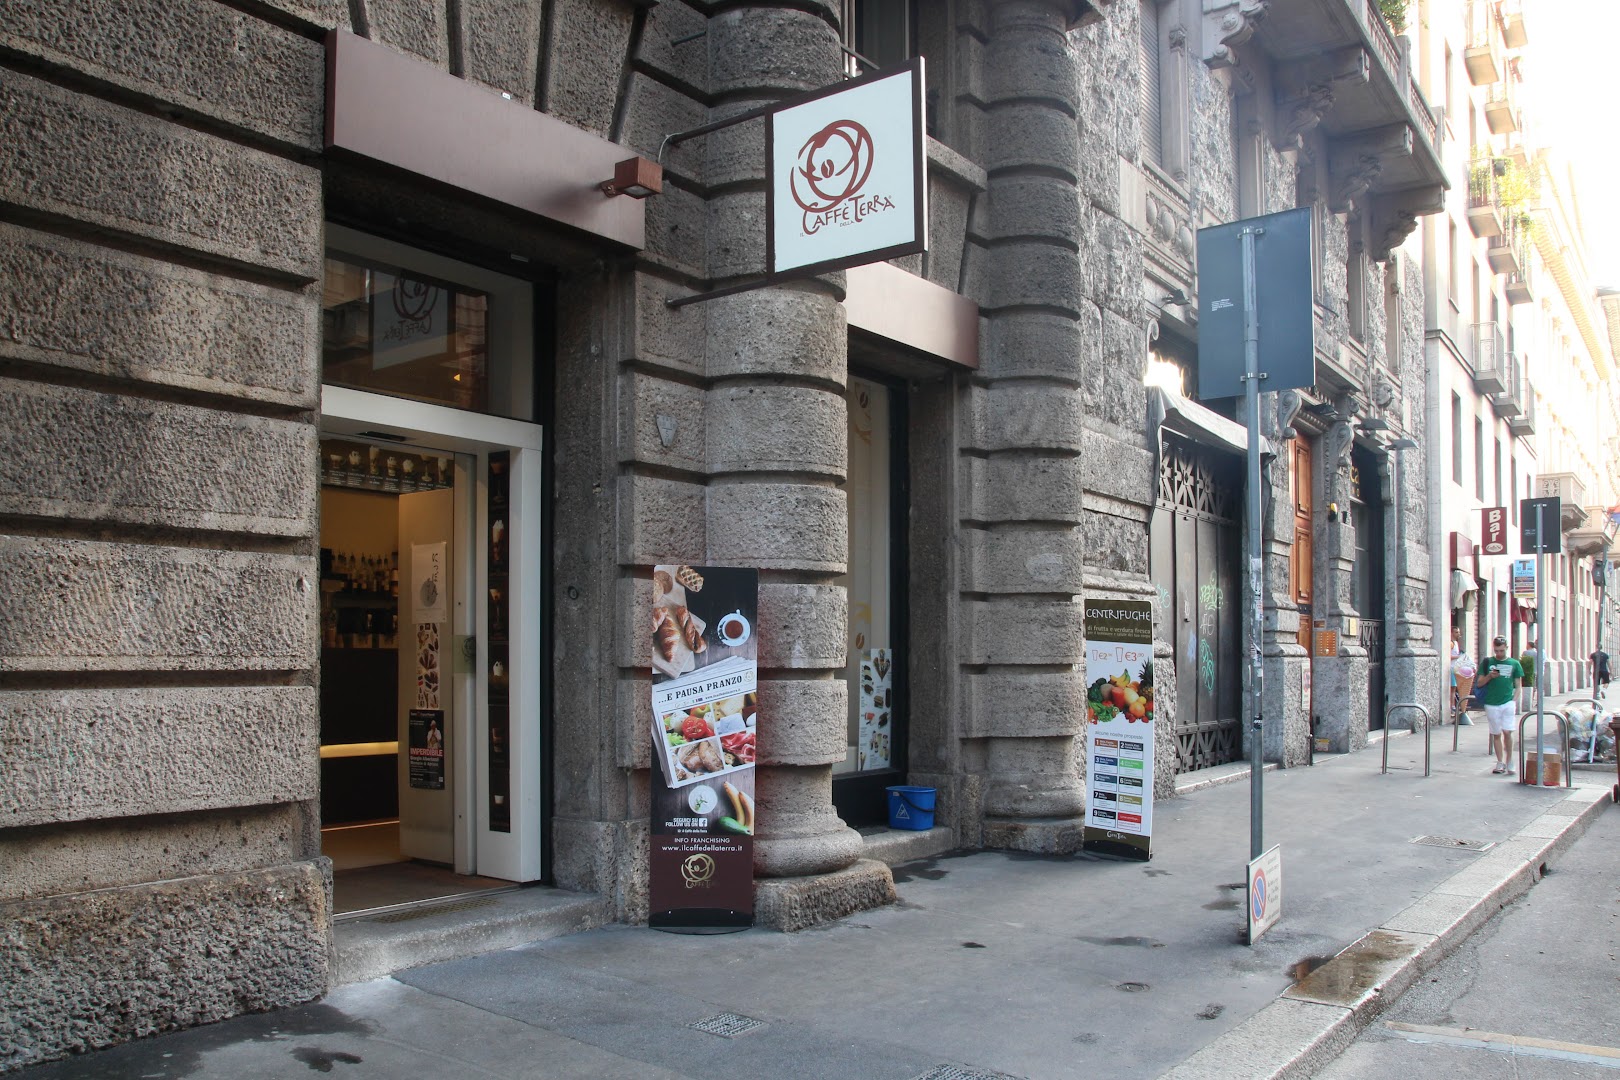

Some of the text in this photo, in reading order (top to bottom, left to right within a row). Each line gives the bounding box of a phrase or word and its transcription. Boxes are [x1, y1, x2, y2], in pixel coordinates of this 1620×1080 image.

[848, 194, 895, 222] TERRA
[1489, 510, 1501, 542] Bar
[1086, 609, 1150, 621] CENTRIFUGHE
[676, 685, 704, 699] PAUSA
[707, 675, 742, 691] PRANZO
[410, 748, 443, 756] IMPERDIBILE
